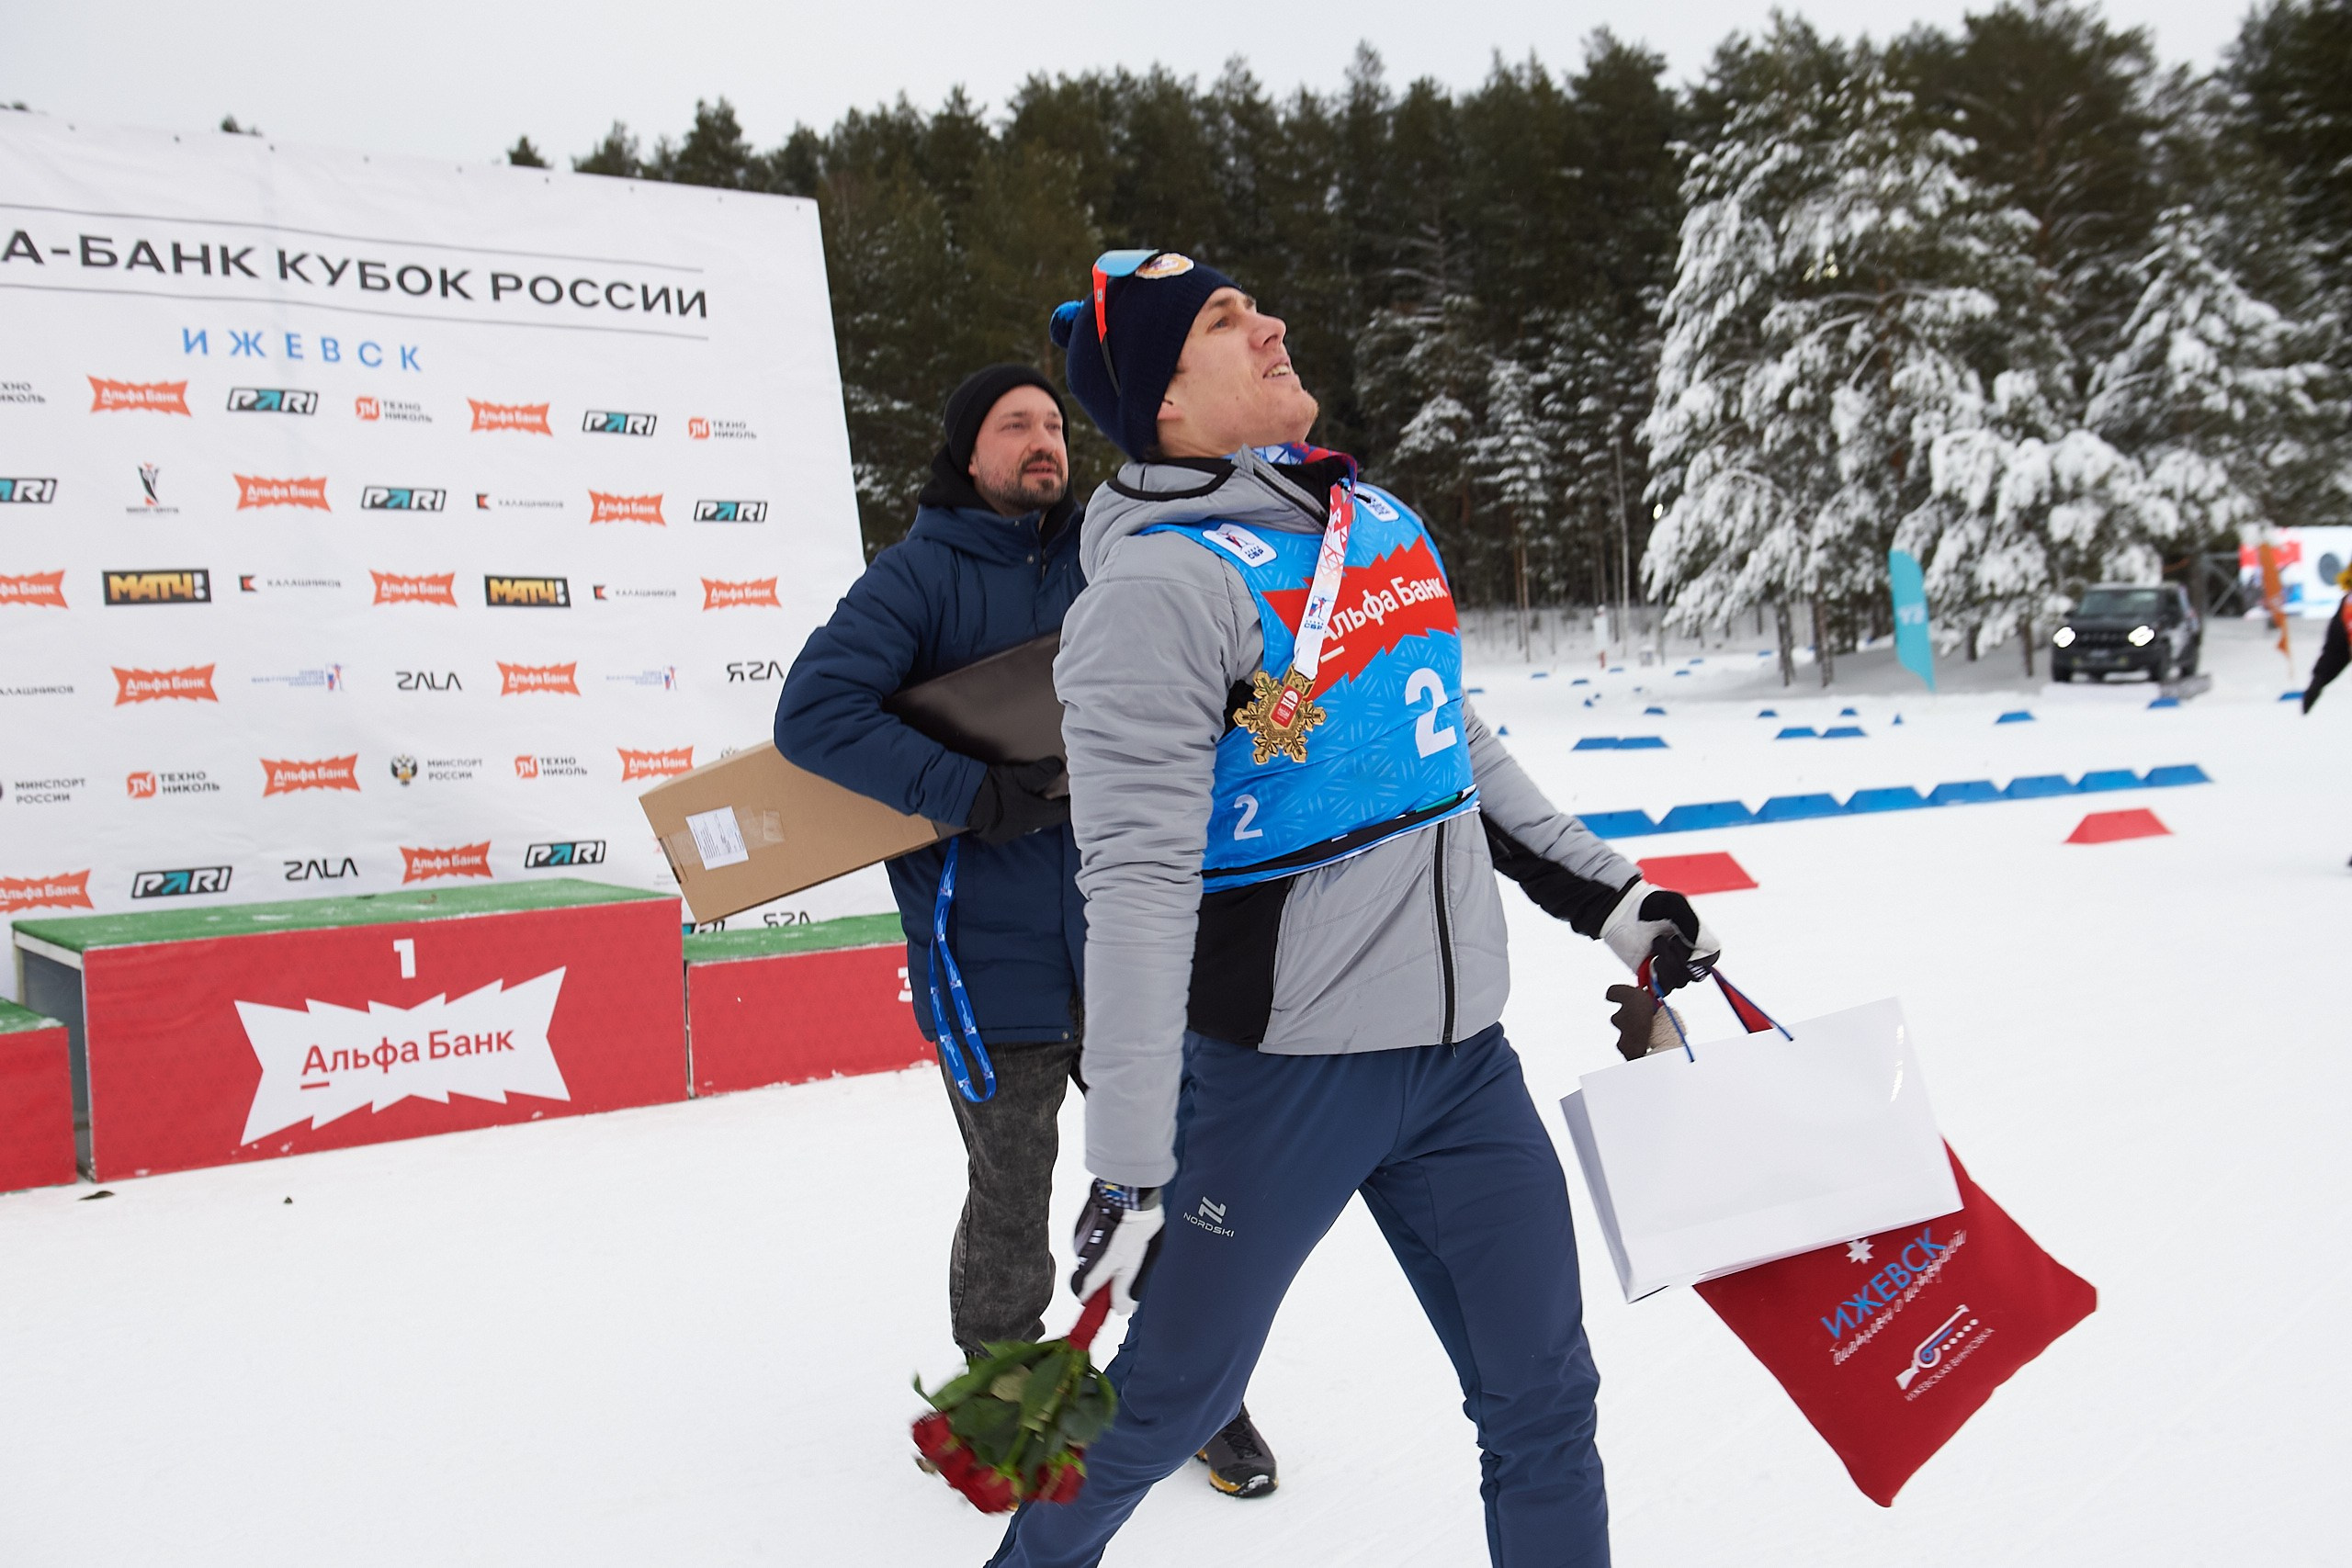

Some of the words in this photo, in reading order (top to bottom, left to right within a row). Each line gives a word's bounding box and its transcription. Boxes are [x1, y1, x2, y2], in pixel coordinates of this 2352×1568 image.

[1, 230, 260, 279] А-БАНК
[278, 249, 473, 301] КУБОК
[491, 271, 707, 319] РОССИИ
[183, 328, 422, 372] ИЖЕВСК
[101, 387, 144, 403] Альфа
[145, 389, 178, 403] Банк
[228, 389, 319, 414] PARI
[382, 400, 421, 411] ТЕХНО
[385, 412, 433, 423] НИКОЛЬ
[479, 408, 513, 424] Альфа
[514, 411, 542, 423] Банк
[583, 411, 656, 436] PARI
[713, 420, 746, 430] ТЕХНО
[715, 430, 757, 439] НИКОЛЬ
[247, 484, 288, 499] Альфа
[289, 485, 319, 498] Банк
[362, 486, 446, 511] PARI
[598, 500, 629, 515] Альфа
[631, 502, 656, 515] Банк
[695, 500, 767, 523] PARI
[107, 572, 207, 602] МАТЧ!
[380, 579, 417, 595] Альфа
[419, 581, 447, 595] Банк
[488, 578, 567, 604] МАТЧ!
[710, 586, 742, 602] Альфа
[744, 587, 771, 599] Банк
[1390, 576, 1448, 606] Банк
[126, 677, 170, 693] Альфа
[172, 675, 205, 690] Банк
[509, 671, 542, 686] Альфа
[543, 671, 570, 686] Банк
[1404, 667, 1457, 759] 2
[427, 759, 482, 768] МИНСПОРТ
[540, 757, 576, 765] ТЕХНО
[629, 755, 662, 771] Альфа
[662, 756, 687, 769] Банк
[160, 771, 206, 782] ТЕХНО
[274, 767, 315, 783] Альфа
[317, 765, 349, 780] Банк
[428, 771, 472, 781] РОССИИ
[542, 766, 587, 776] НИКОЛЬ
[15, 777, 85, 790] МИНСПОРТ
[163, 783, 220, 795] НИКОЛЬ
[17, 793, 70, 805] РОССИИ
[1233, 794, 1263, 840] 2
[413, 852, 449, 869] Альфа
[451, 852, 481, 867] Банк
[525, 840, 605, 868] PARI
[132, 867, 232, 898] PARI
[393, 939, 416, 978] 1
[301, 1039, 420, 1082] Альфа
[428, 1029, 514, 1060] Банк
[1183, 1212, 1235, 1237] NORDSKI
[1821, 1227, 1947, 1339] ИЖЕВСК
